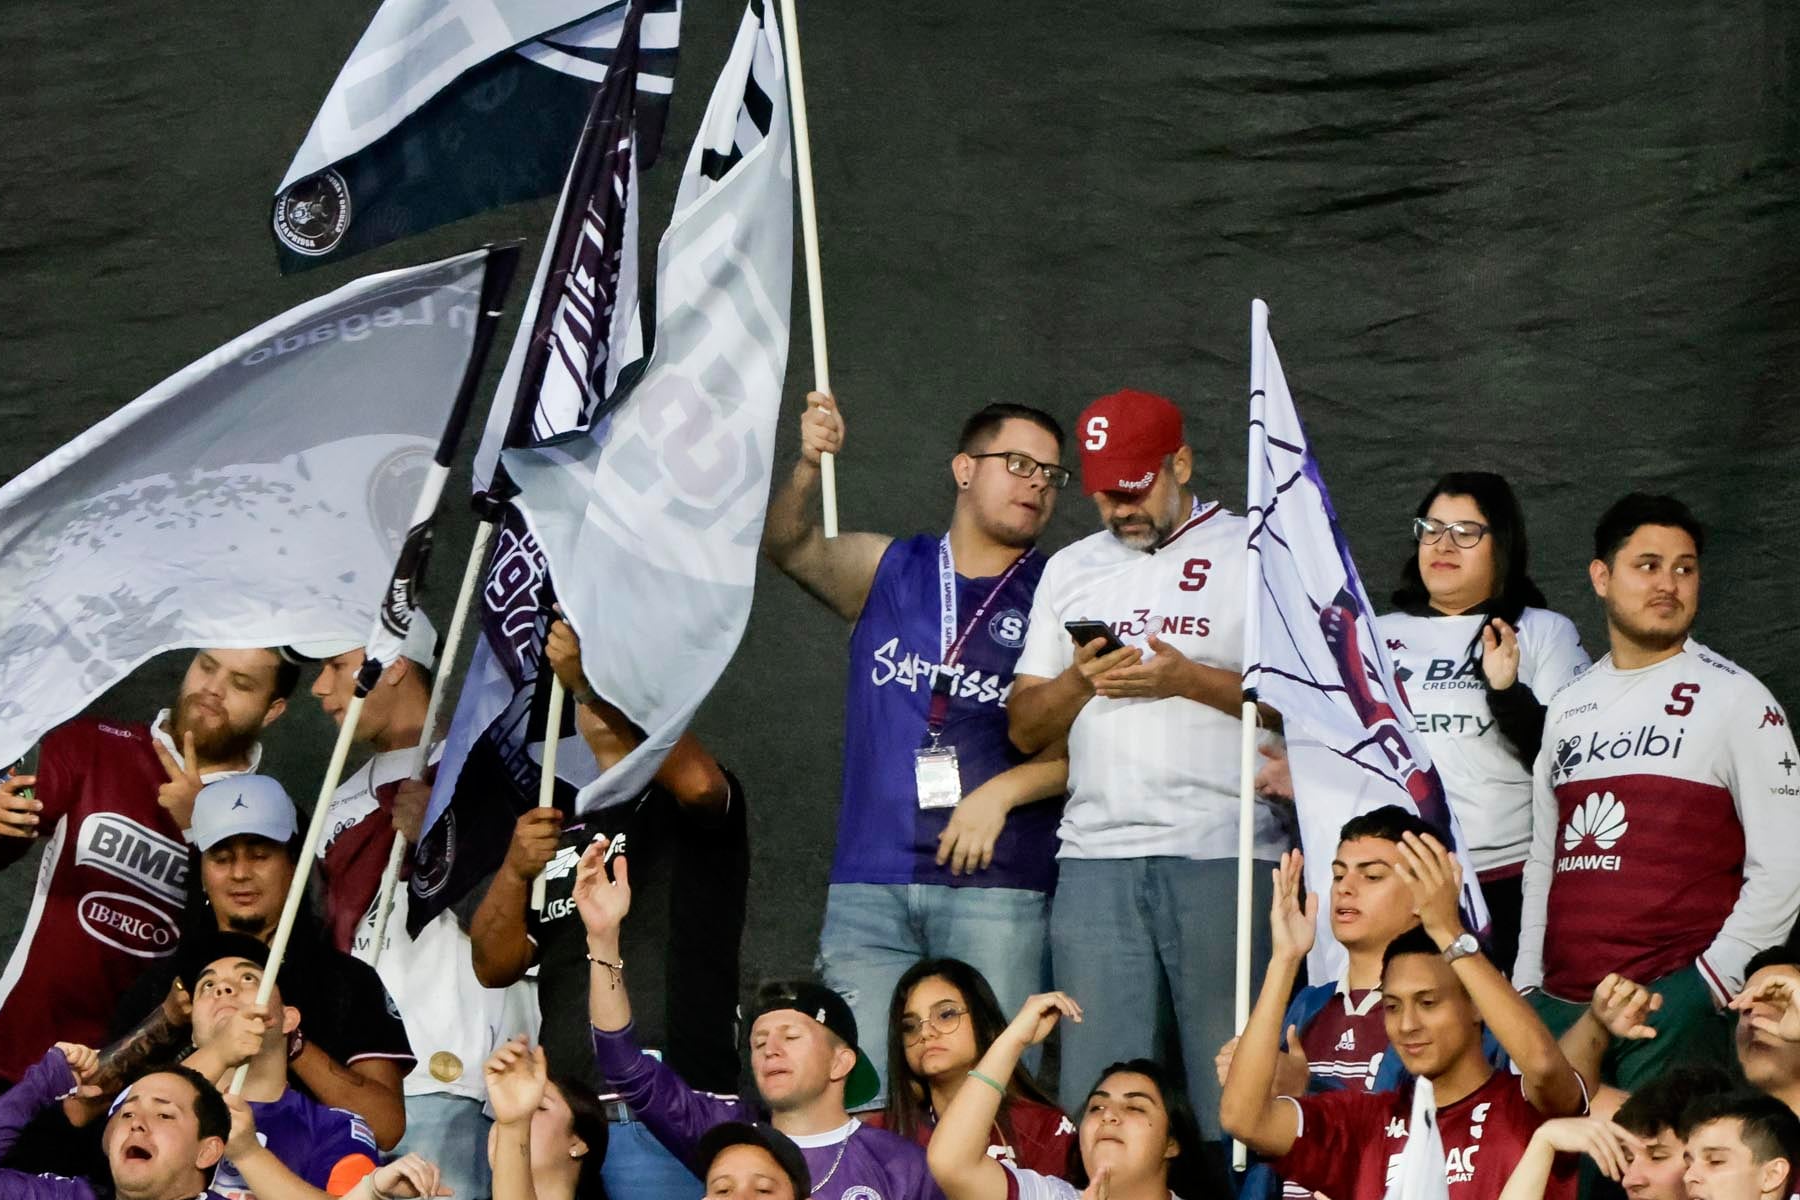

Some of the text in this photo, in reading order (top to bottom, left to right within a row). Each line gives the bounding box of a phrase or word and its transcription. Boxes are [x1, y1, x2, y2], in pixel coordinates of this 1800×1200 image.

[1085, 416, 1109, 450] S
[1178, 558, 1212, 592] S
[1000, 615, 1023, 641] S
[1563, 701, 1598, 719] TOYOTA
[1664, 683, 1700, 718] S
[1586, 724, 1686, 763] kölbi
[1556, 855, 1622, 873] HUAWEI
[87, 901, 169, 946] IBERICO
